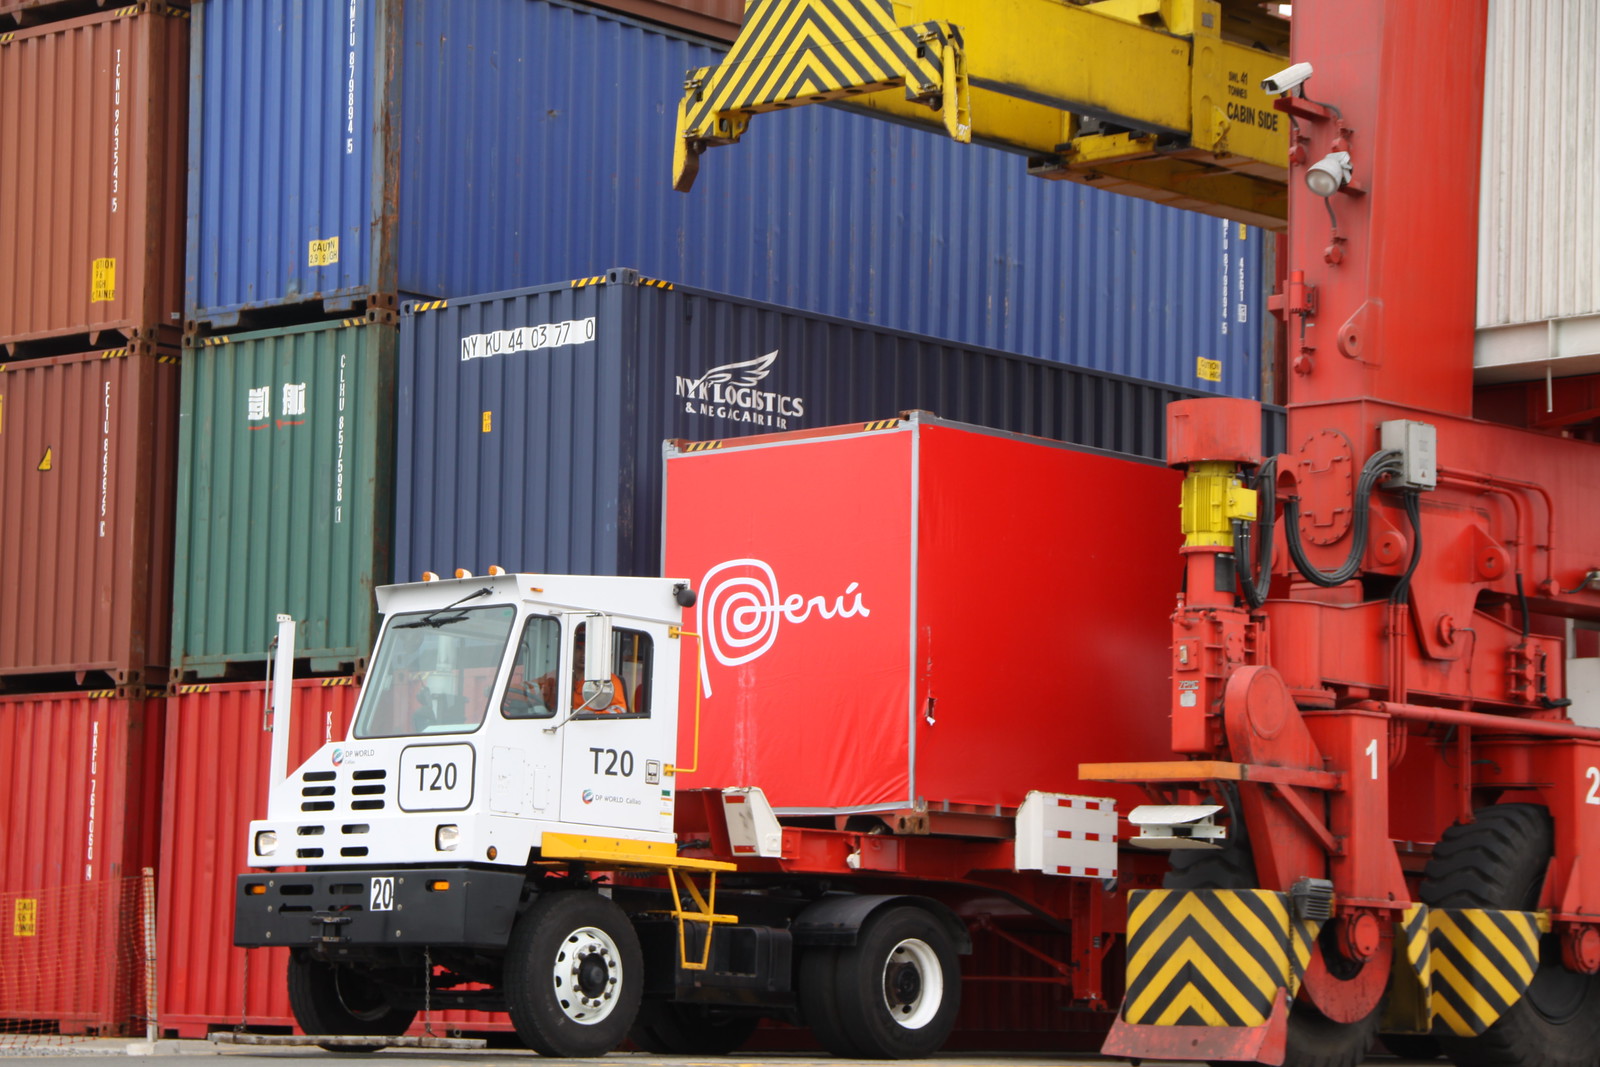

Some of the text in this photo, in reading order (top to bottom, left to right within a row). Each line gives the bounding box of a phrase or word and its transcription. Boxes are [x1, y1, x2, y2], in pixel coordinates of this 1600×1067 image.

[347, 51, 355, 133] 879894
[1227, 102, 1278, 132] CABIN SIDE
[112, 109, 120, 193] 963543
[346, 138, 353, 154] 5
[111, 197, 118, 212] 5
[586, 319, 594, 340] 0
[685, 401, 697, 414] &
[713, 383, 804, 417] LOGISTICS
[336, 415, 344, 502] 857598
[334, 506, 341, 523] 1
[696, 558, 870, 699] Perú
[354, 749, 375, 757] WORLD
[589, 747, 634, 777] T20
[1365, 739, 1378, 780] 1
[416, 762, 458, 792] T20
[1585, 766, 1600, 805] 2
[372, 878, 392, 910] 20
